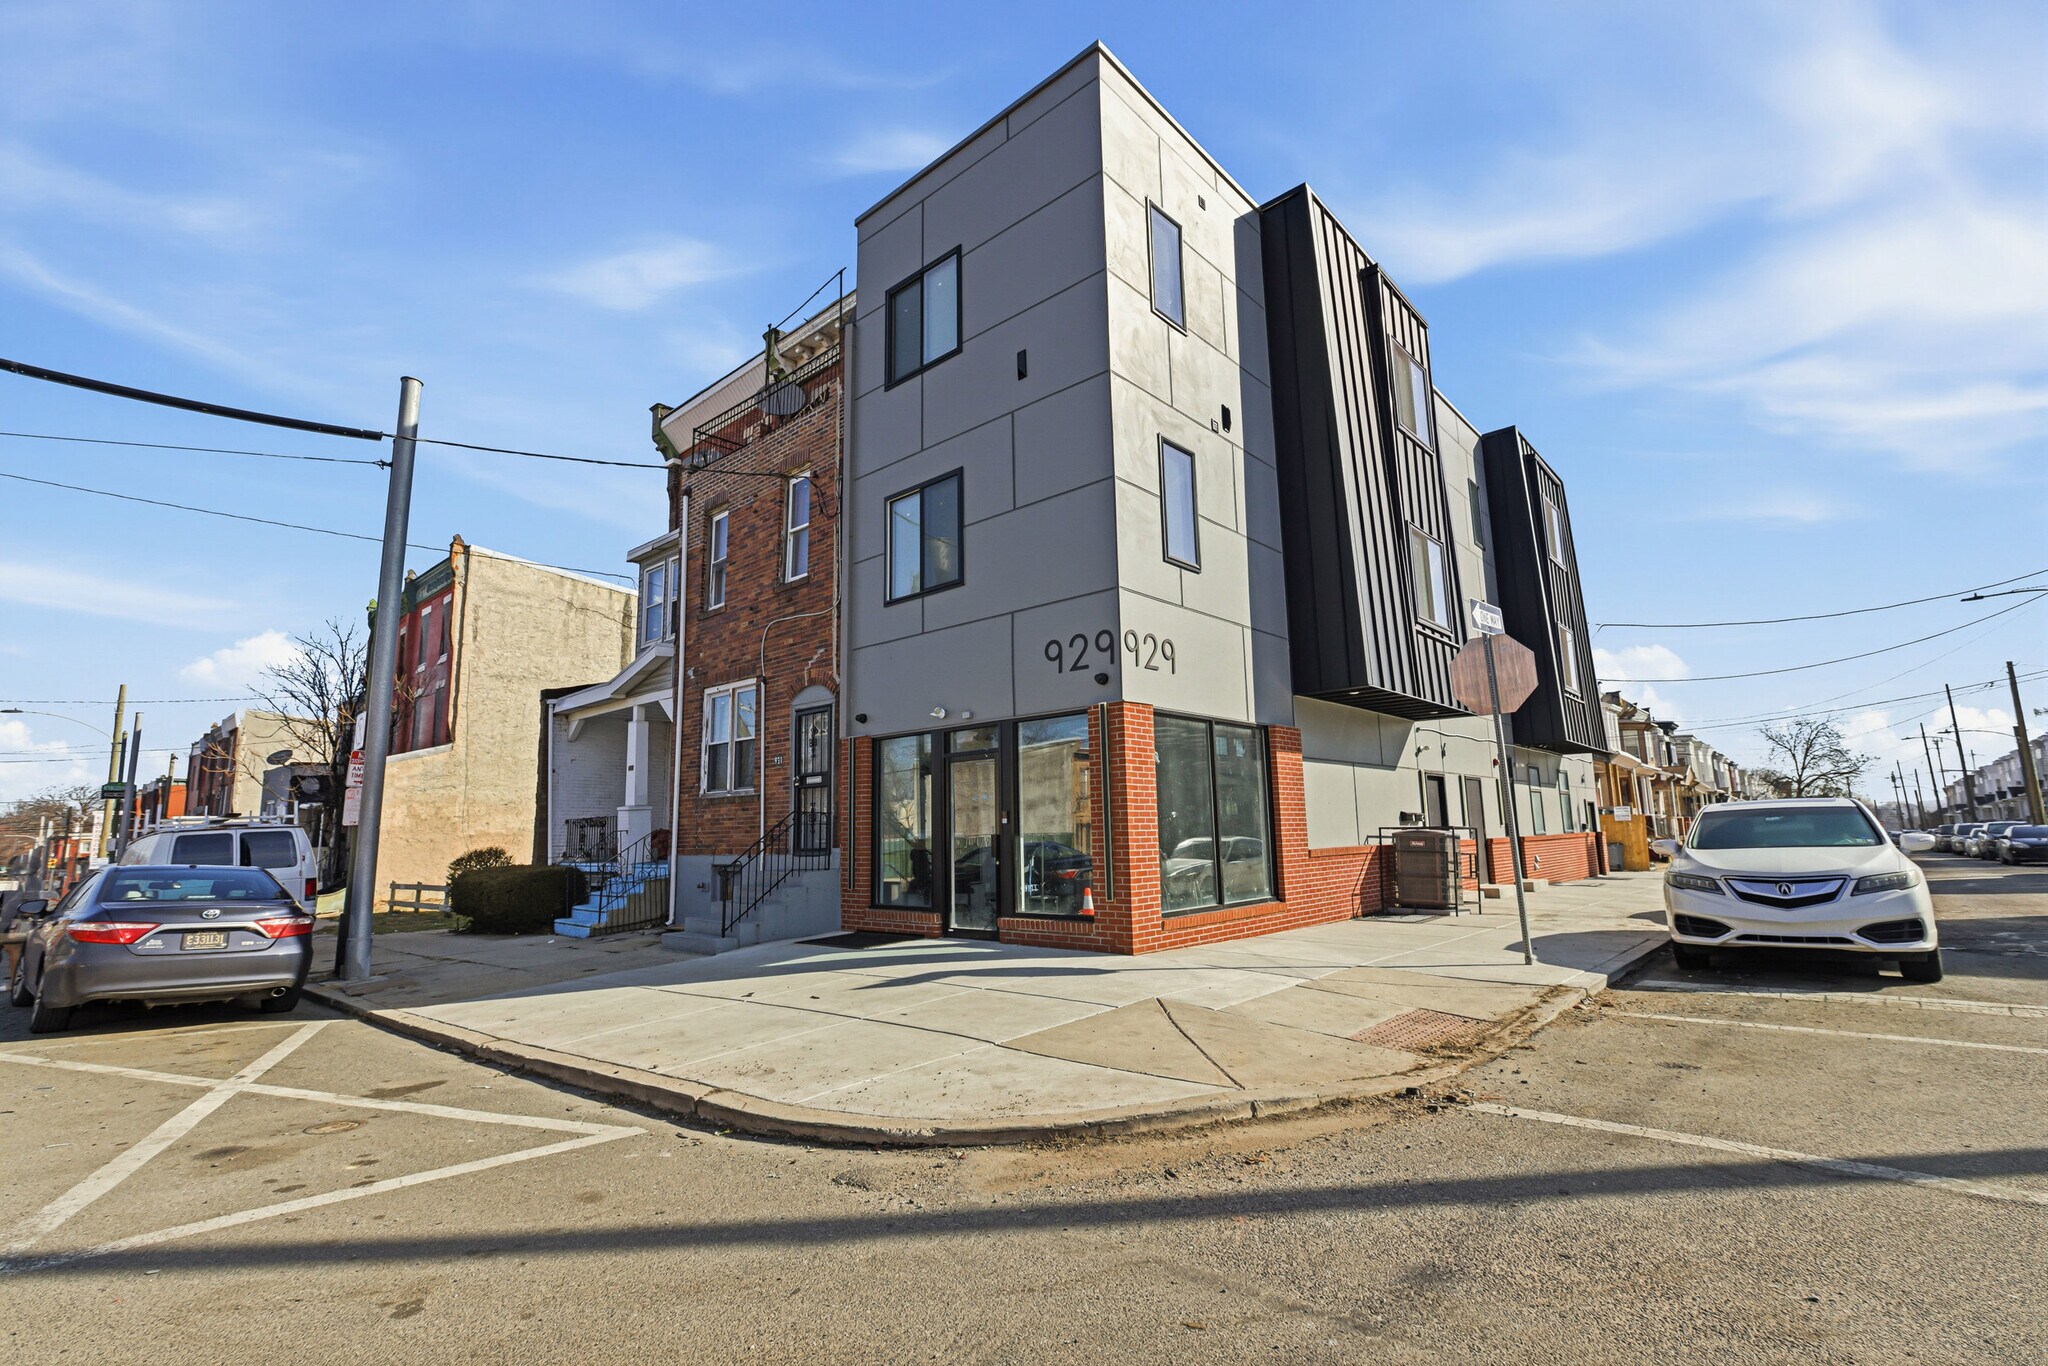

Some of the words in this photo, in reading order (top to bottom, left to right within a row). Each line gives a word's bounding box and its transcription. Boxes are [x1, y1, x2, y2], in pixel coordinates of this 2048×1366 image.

[1480, 610, 1490, 625] ONE
[1044, 629, 1115, 674] 929
[1124, 629, 1176, 675] 929
